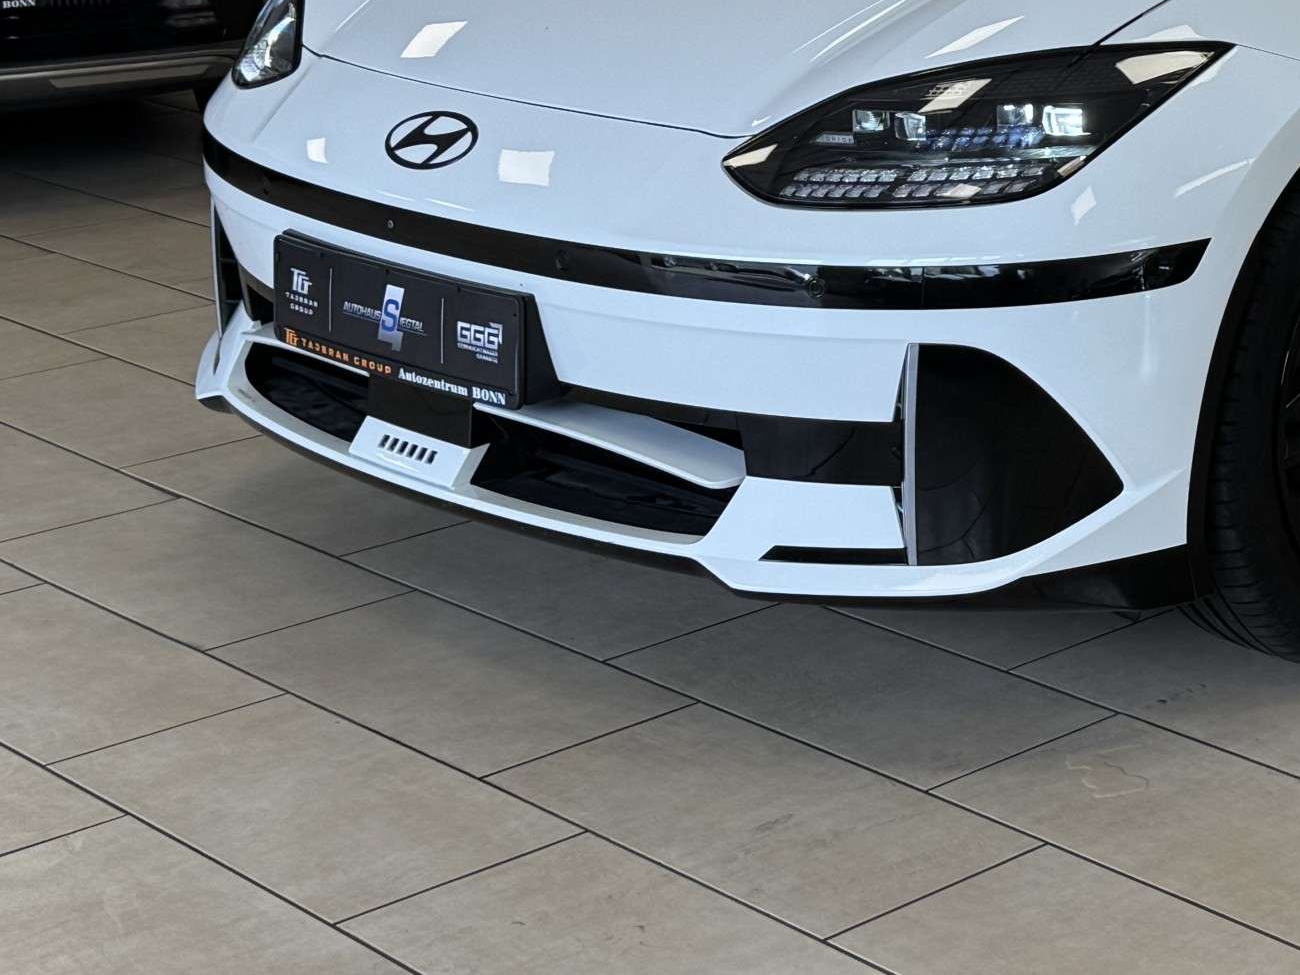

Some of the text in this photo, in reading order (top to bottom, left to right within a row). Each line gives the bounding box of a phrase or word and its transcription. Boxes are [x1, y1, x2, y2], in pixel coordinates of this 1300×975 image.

[343, 301, 383, 320] AUTOHAUS
[457, 321, 499, 351] GGG
[354, 357, 392, 374] GROUP
[398, 368, 506, 406] Autozentrum BONN
